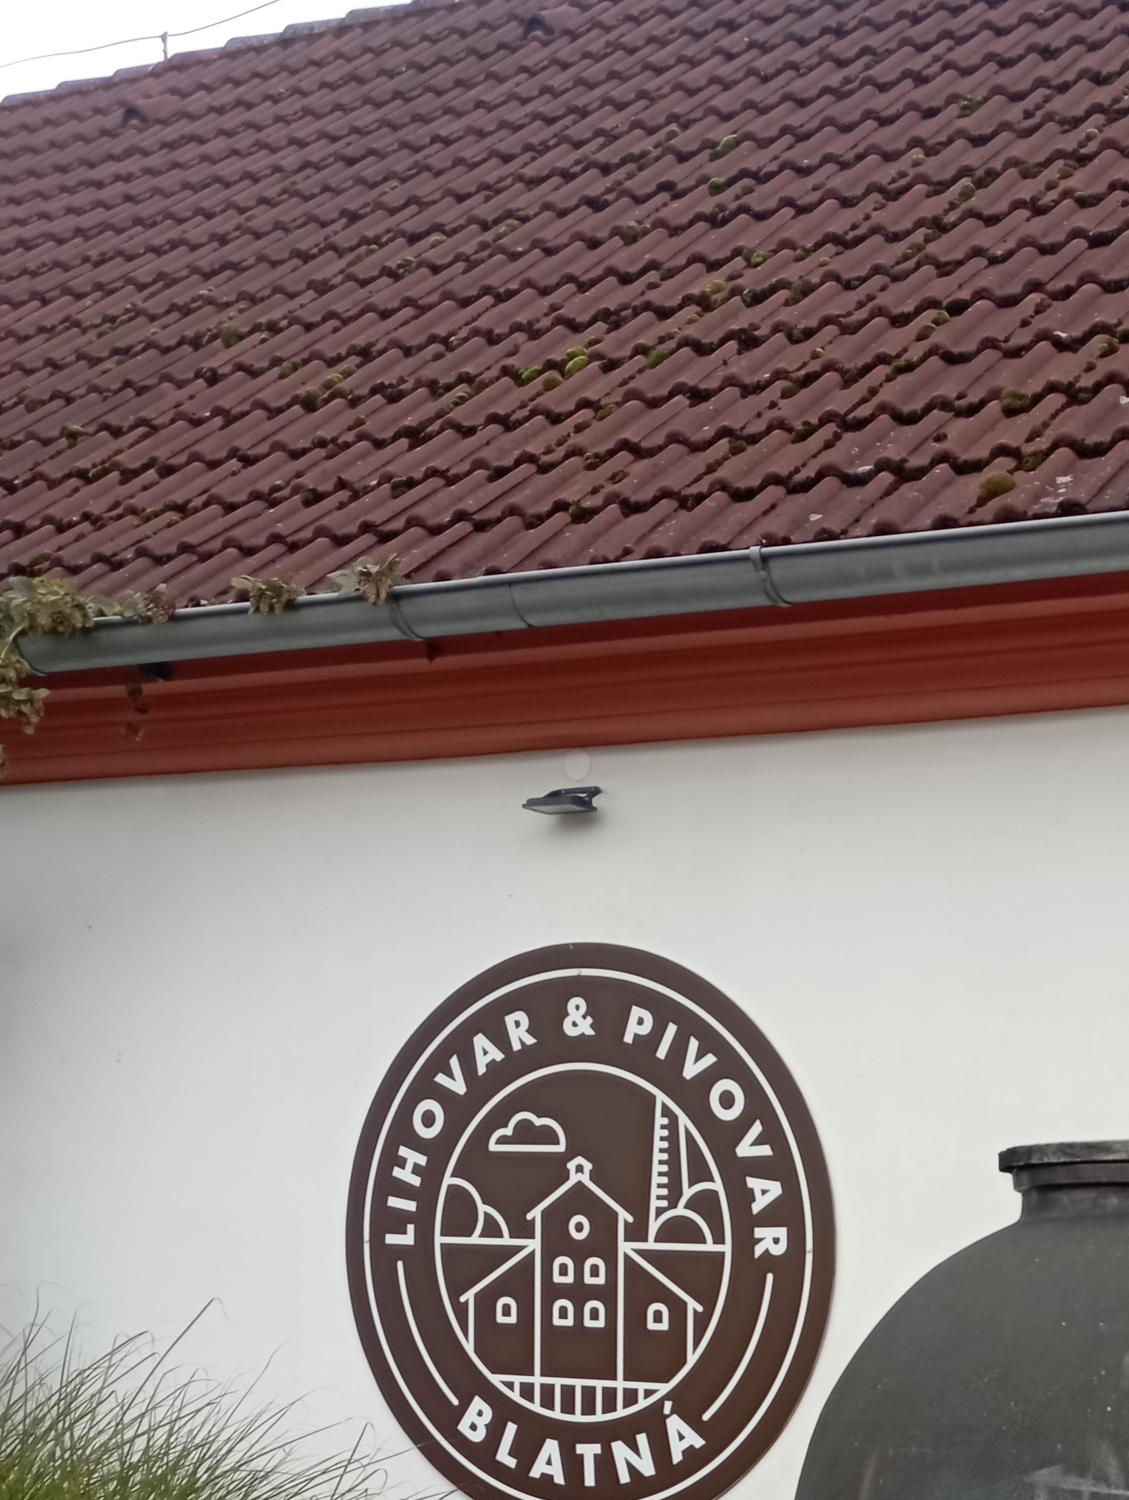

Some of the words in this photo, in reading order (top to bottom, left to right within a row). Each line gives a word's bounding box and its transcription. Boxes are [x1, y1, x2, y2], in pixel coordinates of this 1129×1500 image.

[385, 1010, 537, 1245] LIHOVAR
[563, 996, 595, 1037] &
[623, 1005, 788, 1259] PIVOVAR
[456, 1395, 707, 1487] BLATNÁ
